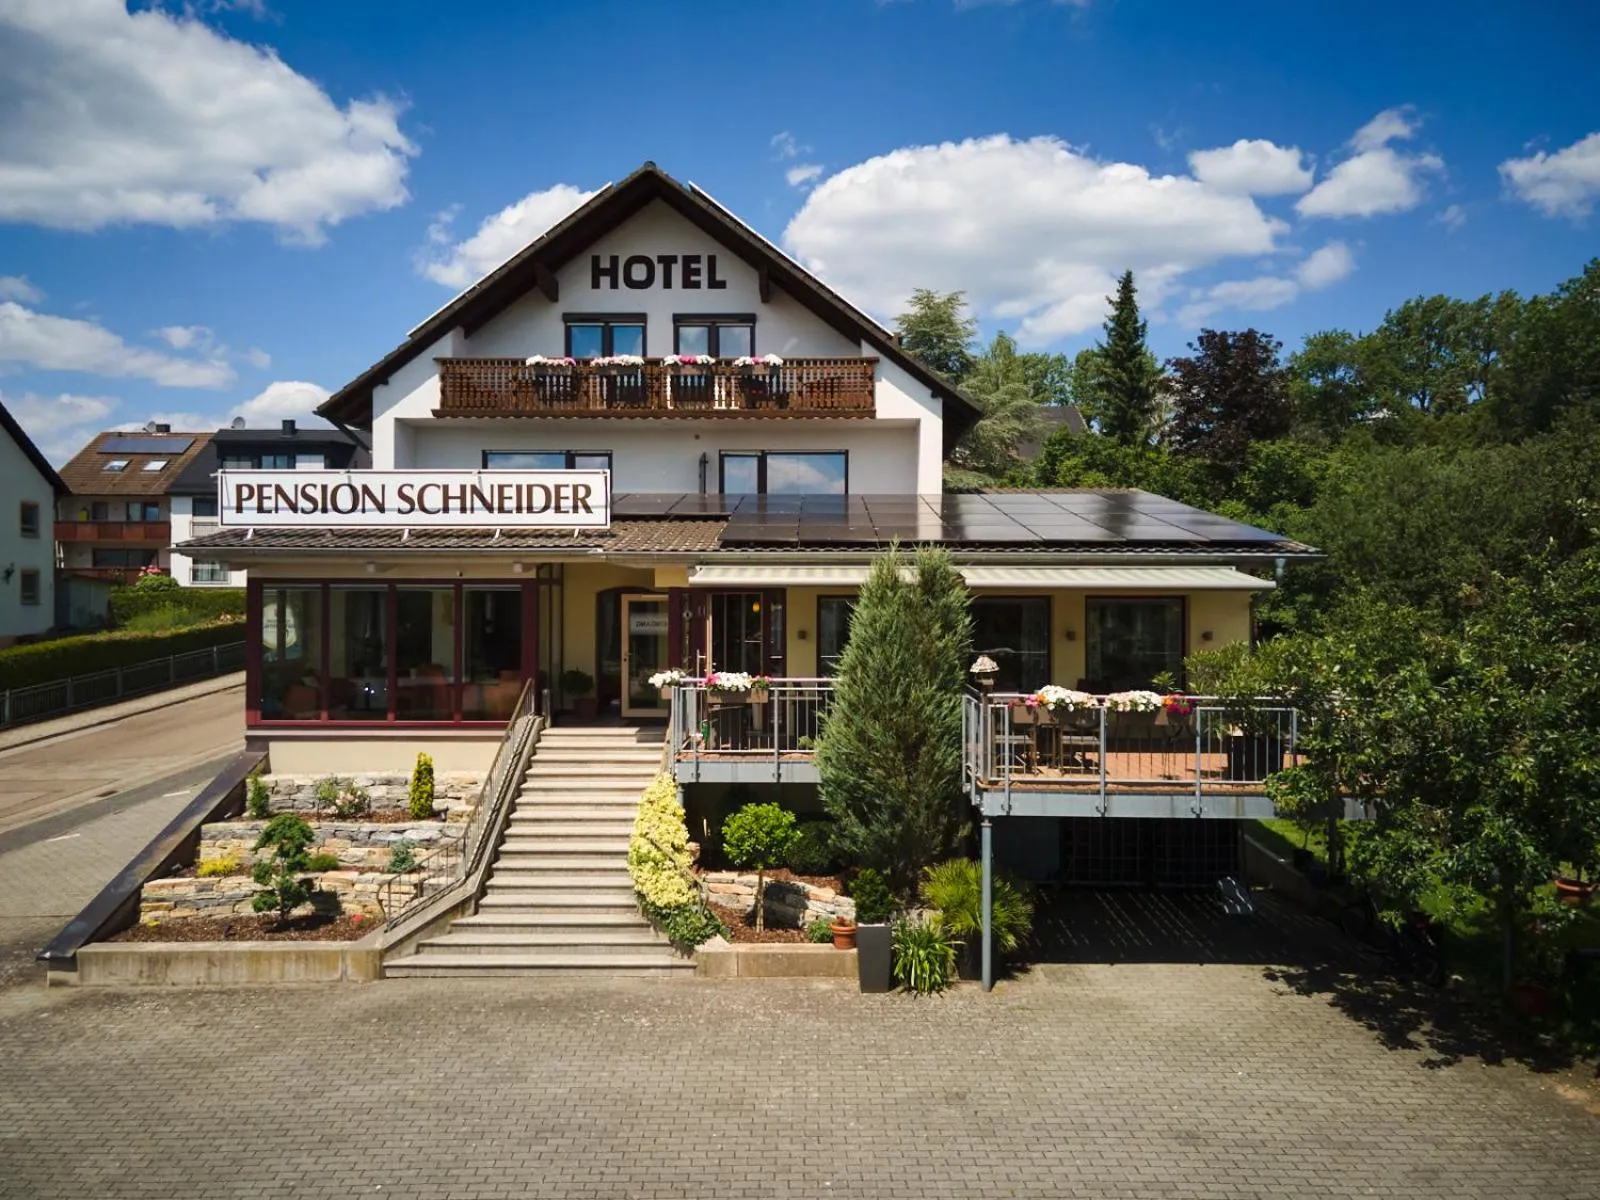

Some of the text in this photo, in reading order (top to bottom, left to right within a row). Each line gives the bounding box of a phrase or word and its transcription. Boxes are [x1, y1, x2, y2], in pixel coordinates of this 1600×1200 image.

[591, 255, 727, 289] HOTEL
[235, 483, 594, 515] PENSION SCHNEIDER
